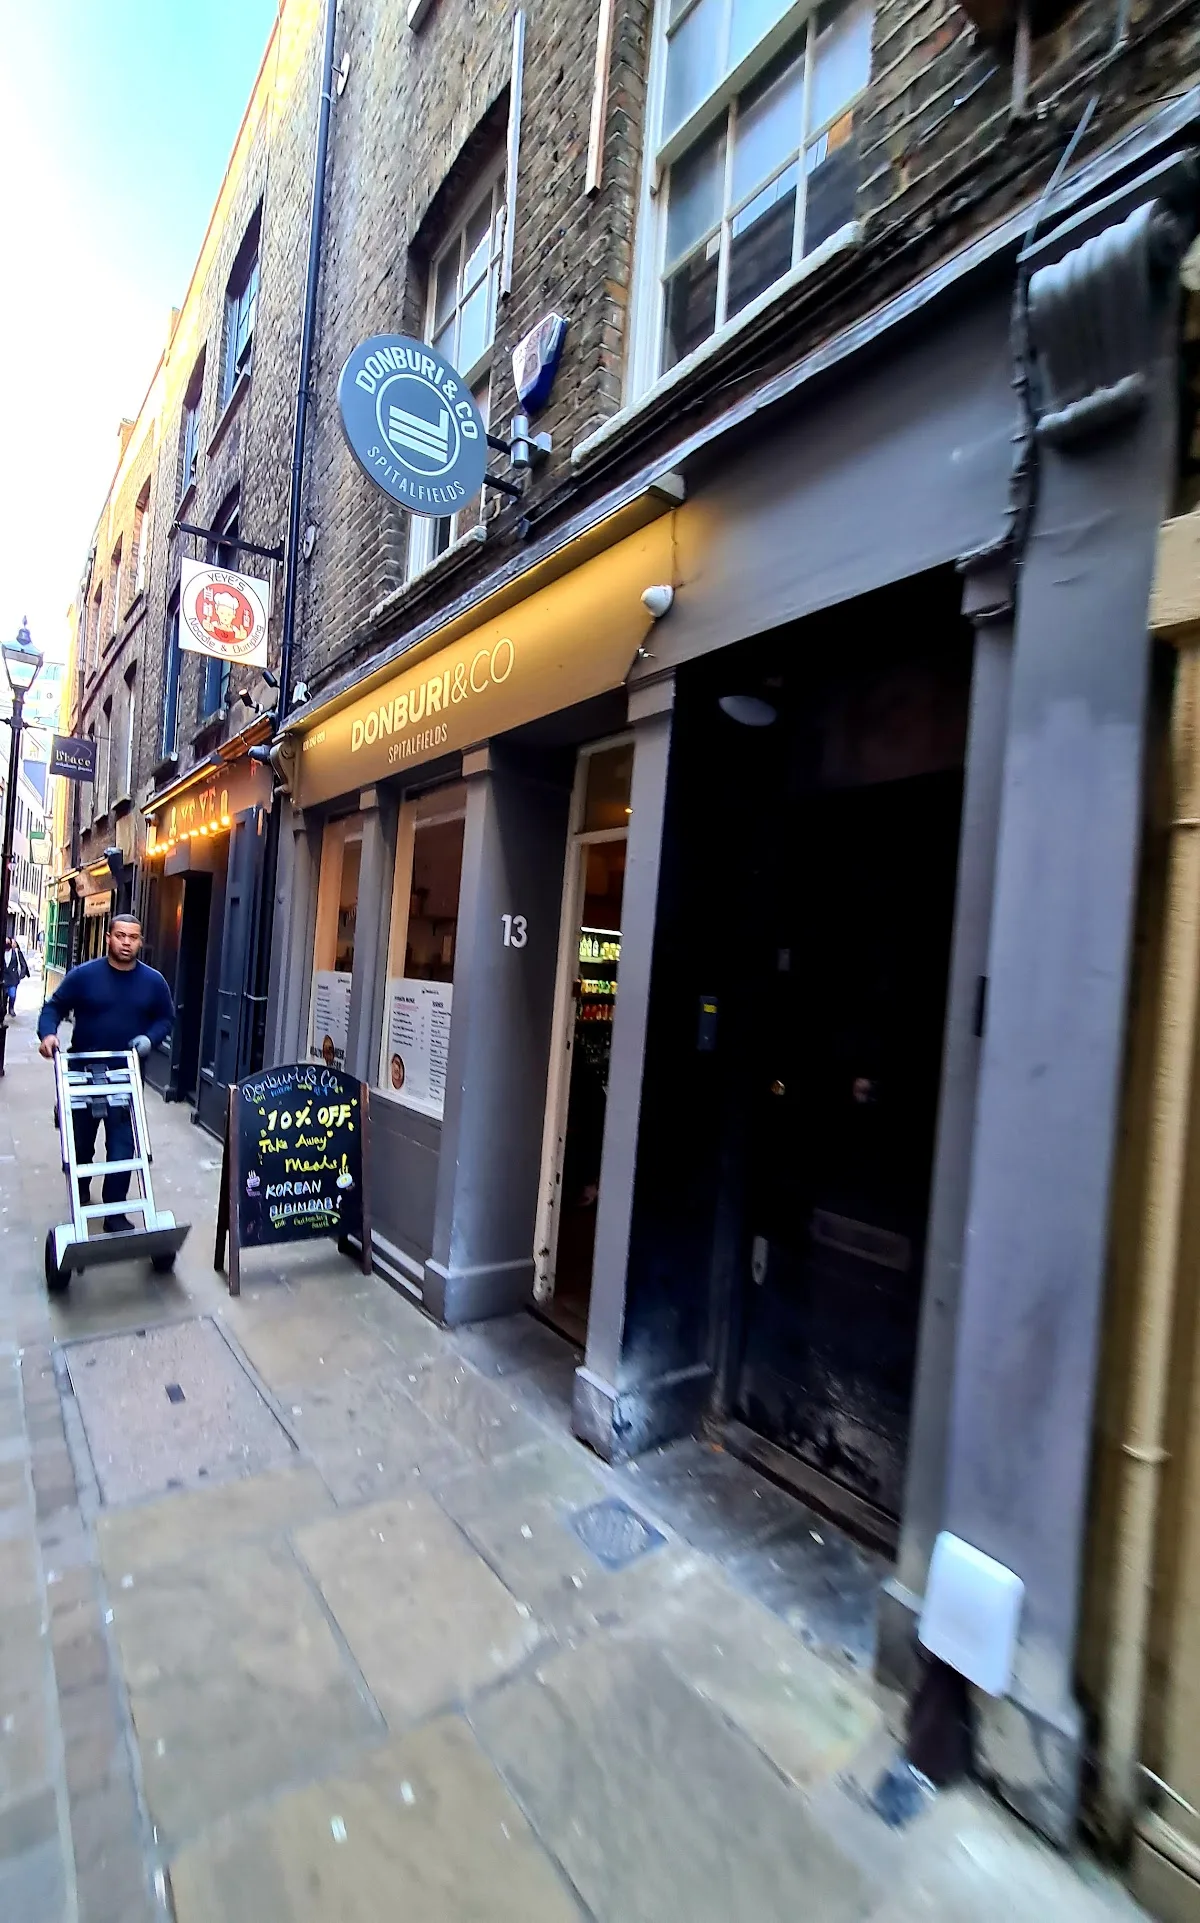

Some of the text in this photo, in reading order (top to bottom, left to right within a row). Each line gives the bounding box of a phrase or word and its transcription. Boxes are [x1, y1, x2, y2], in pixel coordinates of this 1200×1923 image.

[355, 346, 479, 440] DONBURI & CO
[367, 446, 466, 503] SPITALFIELDS
[207, 572, 246, 592] YEYE'S
[188, 616, 216, 649] Noodle
[232, 624, 265, 655] Dumpling
[387, 723, 449, 764] SPITALFIELDS
[501, 913, 528, 949] 13
[242, 1065, 304, 1103] Donburi
[317, 1103, 352, 1128] OFF
[258, 1133, 328, 1154] Take Away
[265, 1179, 322, 1200] KOREAN
